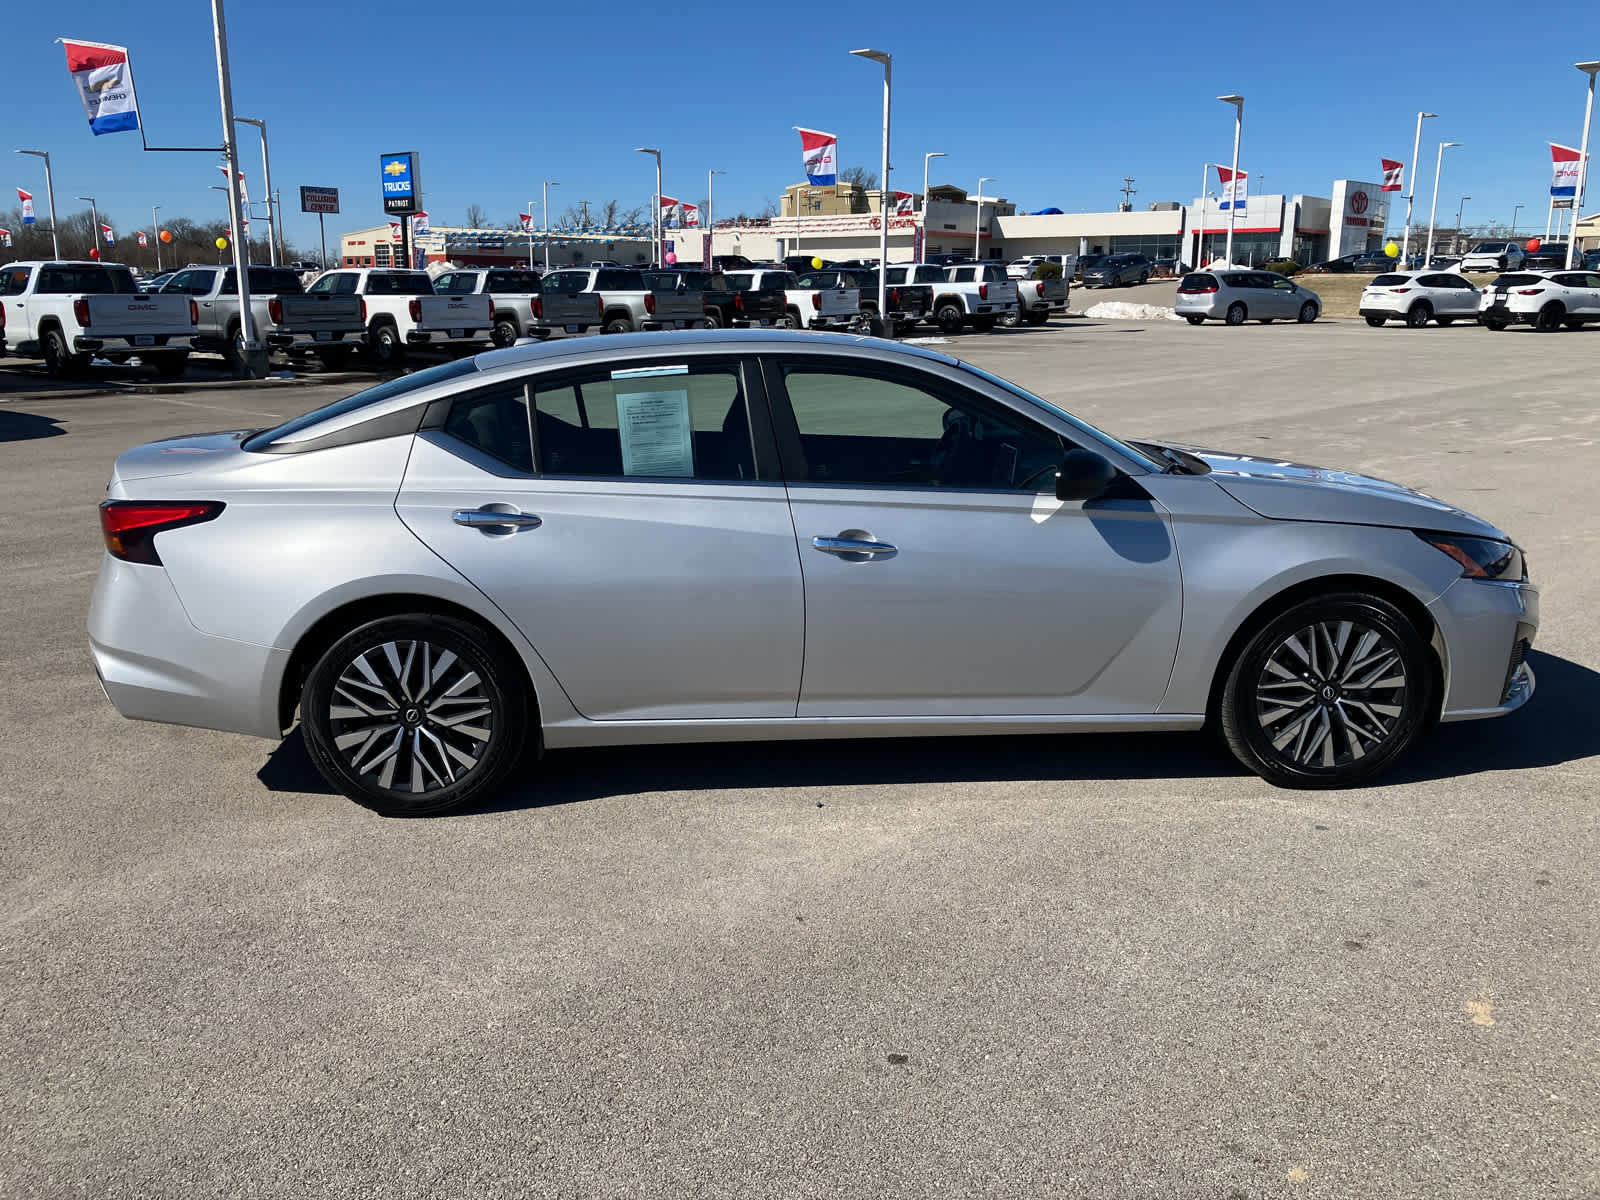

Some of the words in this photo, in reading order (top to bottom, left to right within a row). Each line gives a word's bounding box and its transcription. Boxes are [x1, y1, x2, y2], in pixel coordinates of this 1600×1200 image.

[384, 181, 410, 192] TRUCKS
[306, 194, 337, 203] COLLISION
[310, 203, 334, 211] CENTER
[388, 199, 408, 207] PATRIOT
